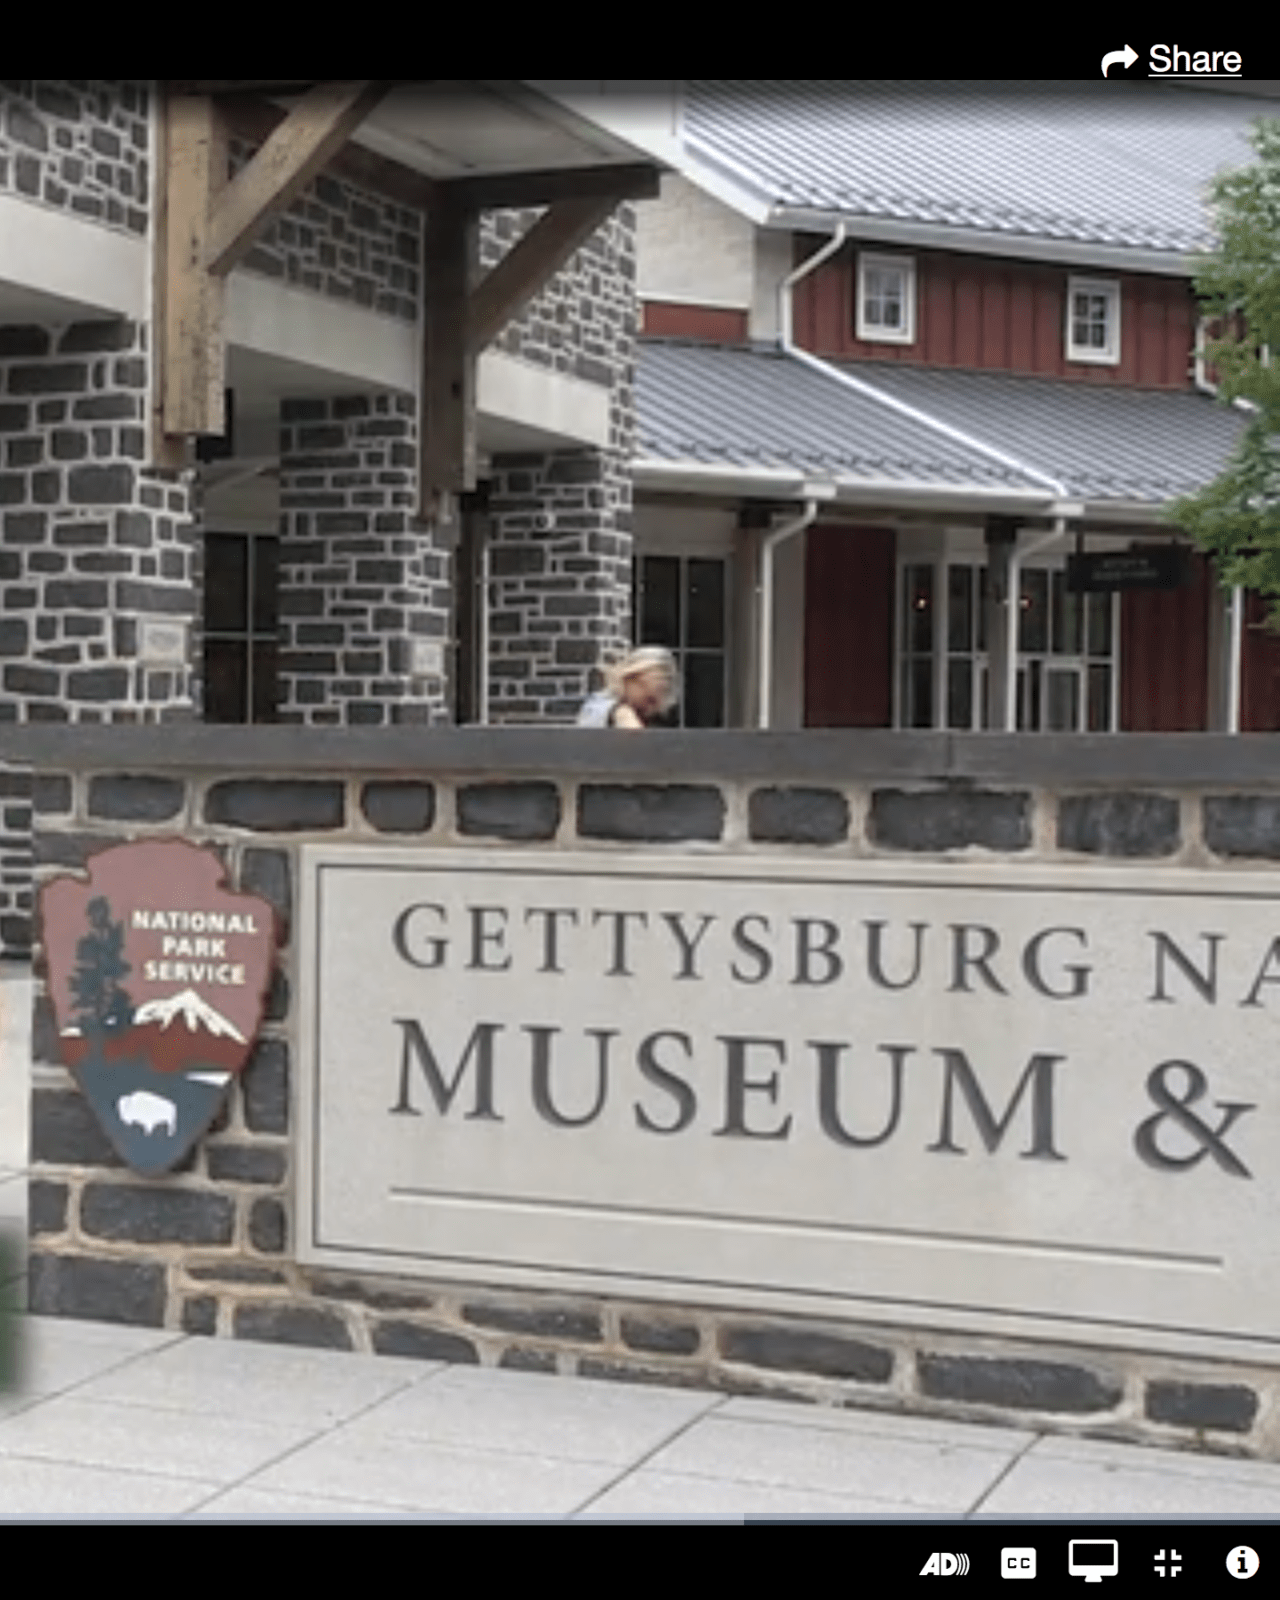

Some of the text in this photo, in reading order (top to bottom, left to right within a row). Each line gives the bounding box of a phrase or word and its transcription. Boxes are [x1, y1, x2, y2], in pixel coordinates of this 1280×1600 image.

[131, 910, 258, 934] NATIONAL
[163, 936, 225, 957] PARK
[392, 903, 1093, 1000] GETTYSBURG
[145, 961, 246, 984] SERVICE
[388, 1018, 1258, 1180] MUSEUM &
